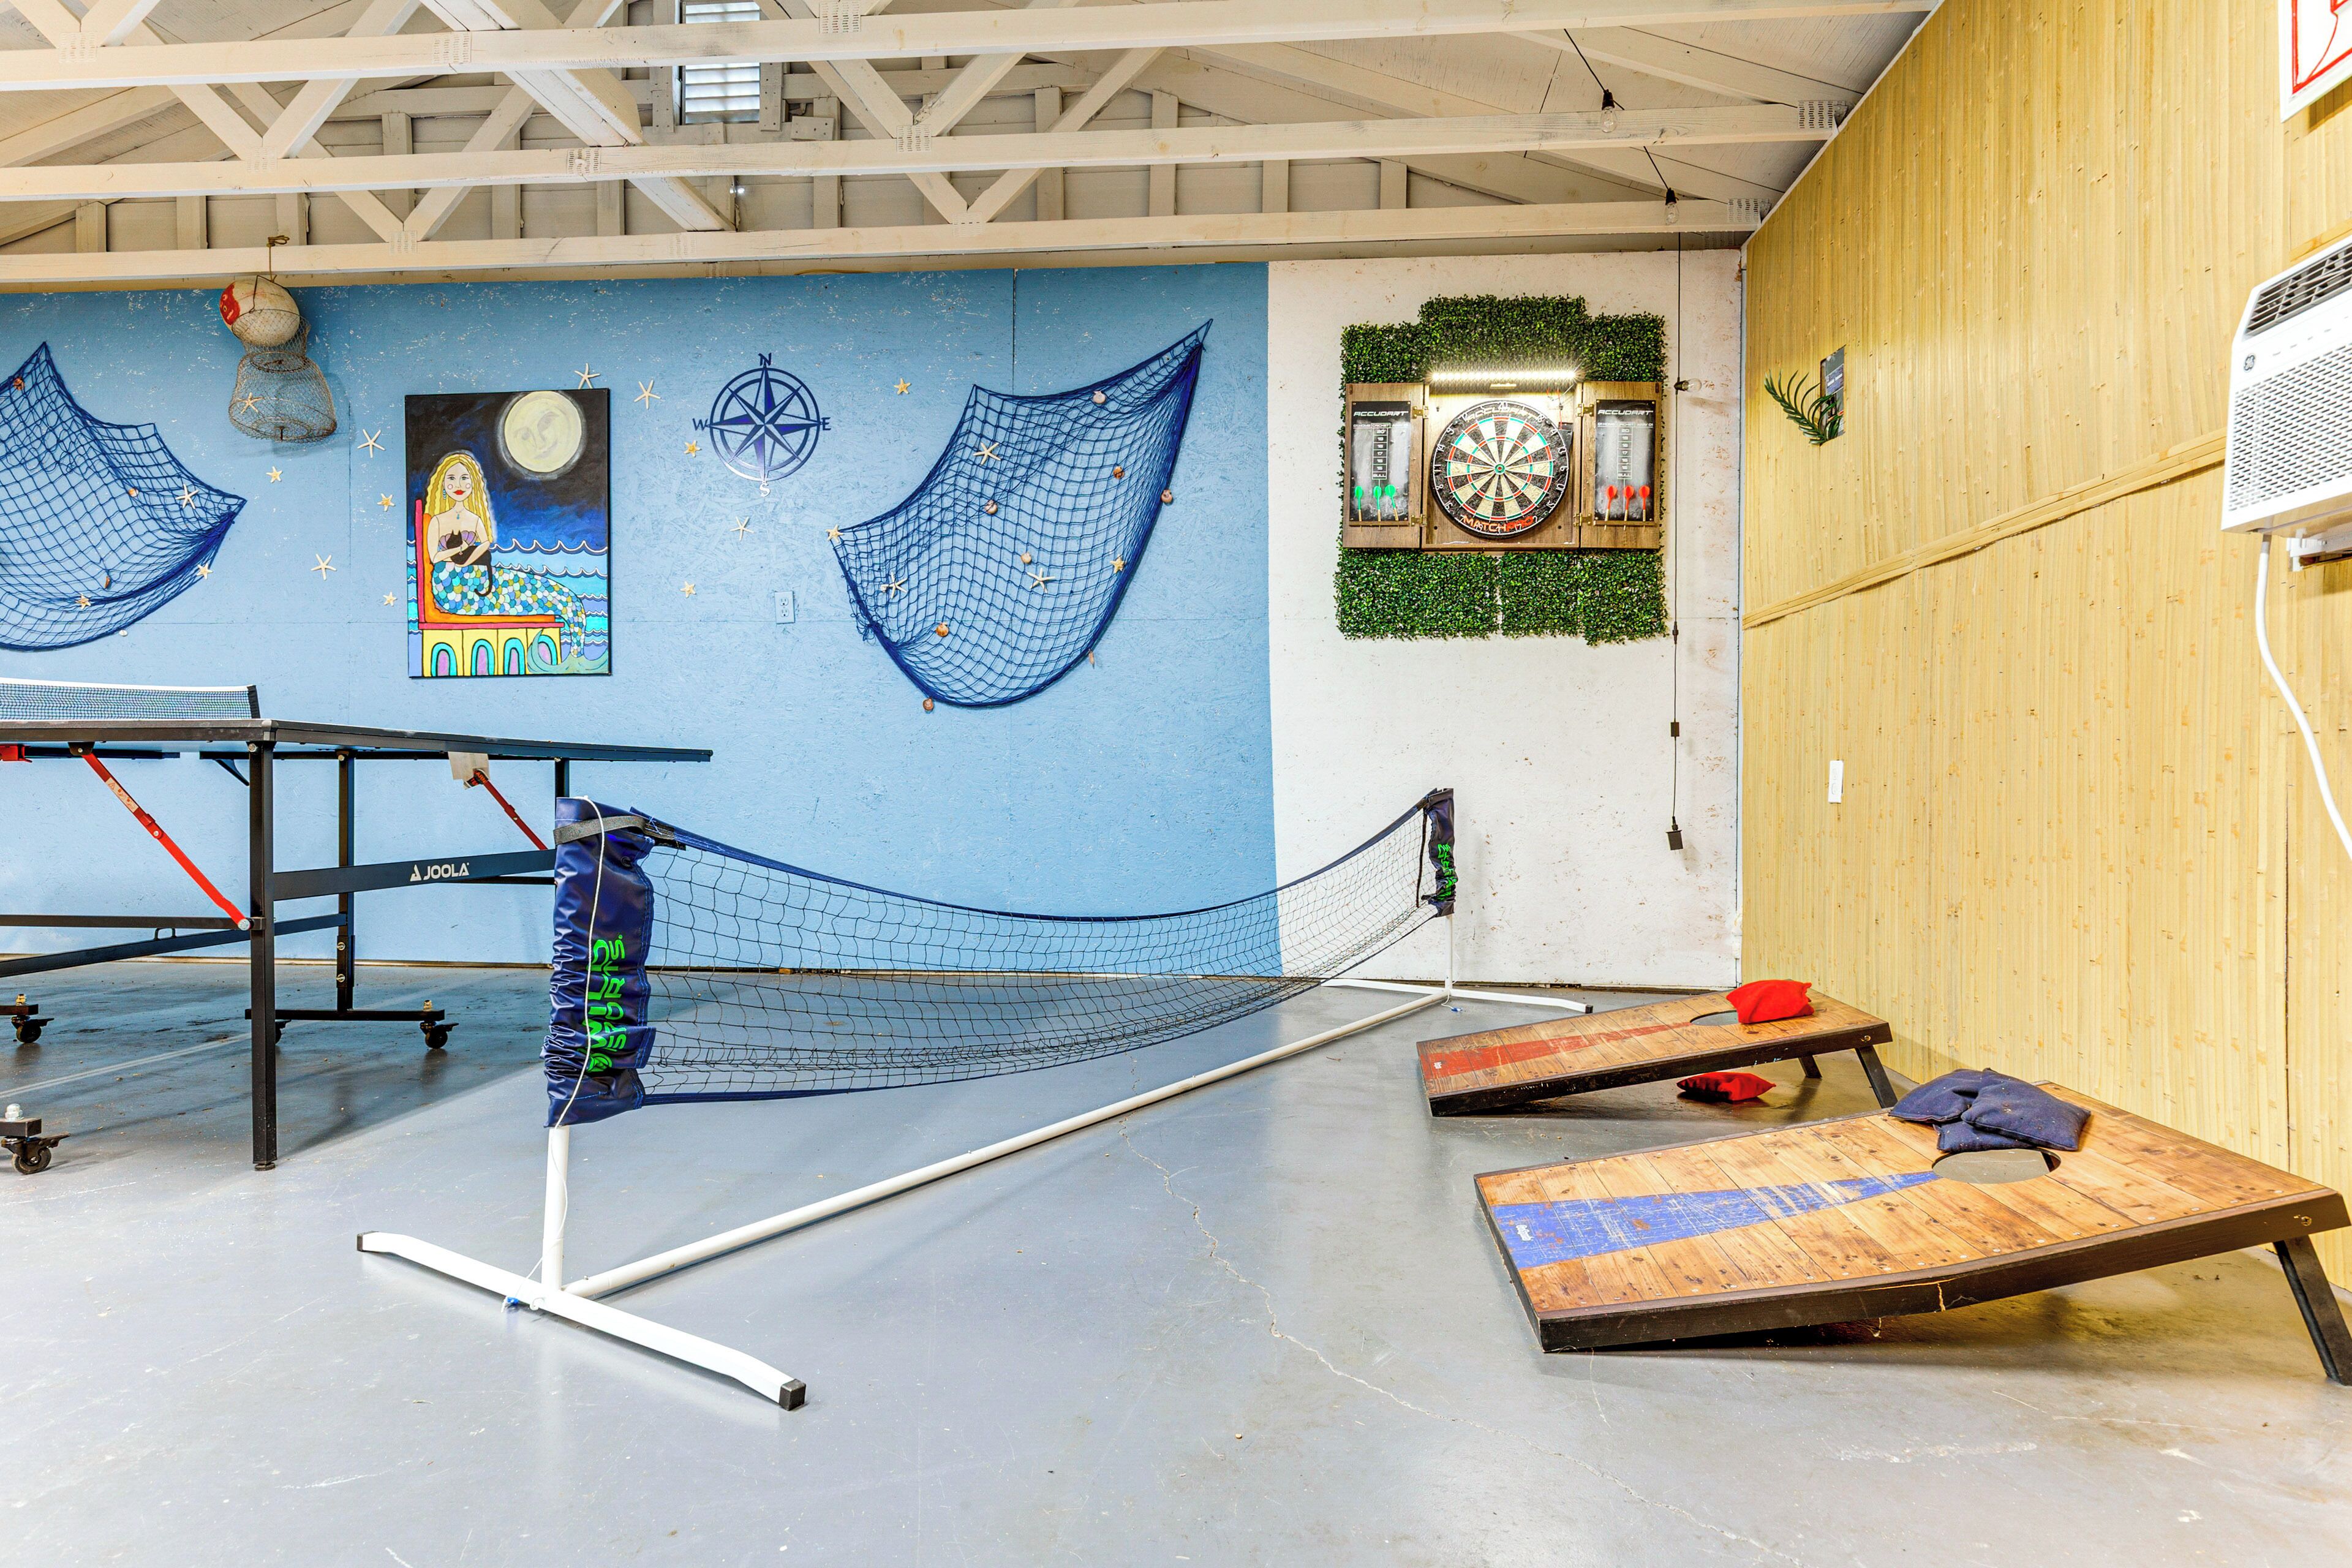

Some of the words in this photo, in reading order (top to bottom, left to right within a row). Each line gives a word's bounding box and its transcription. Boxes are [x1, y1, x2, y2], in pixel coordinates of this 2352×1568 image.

[758, 353, 772, 366] N
[693, 418, 708, 431] W
[821, 417, 831, 431] E
[760, 483, 771, 497] S
[423, 862, 469, 880] JOOLA
[582, 939, 609, 1049] WILD
